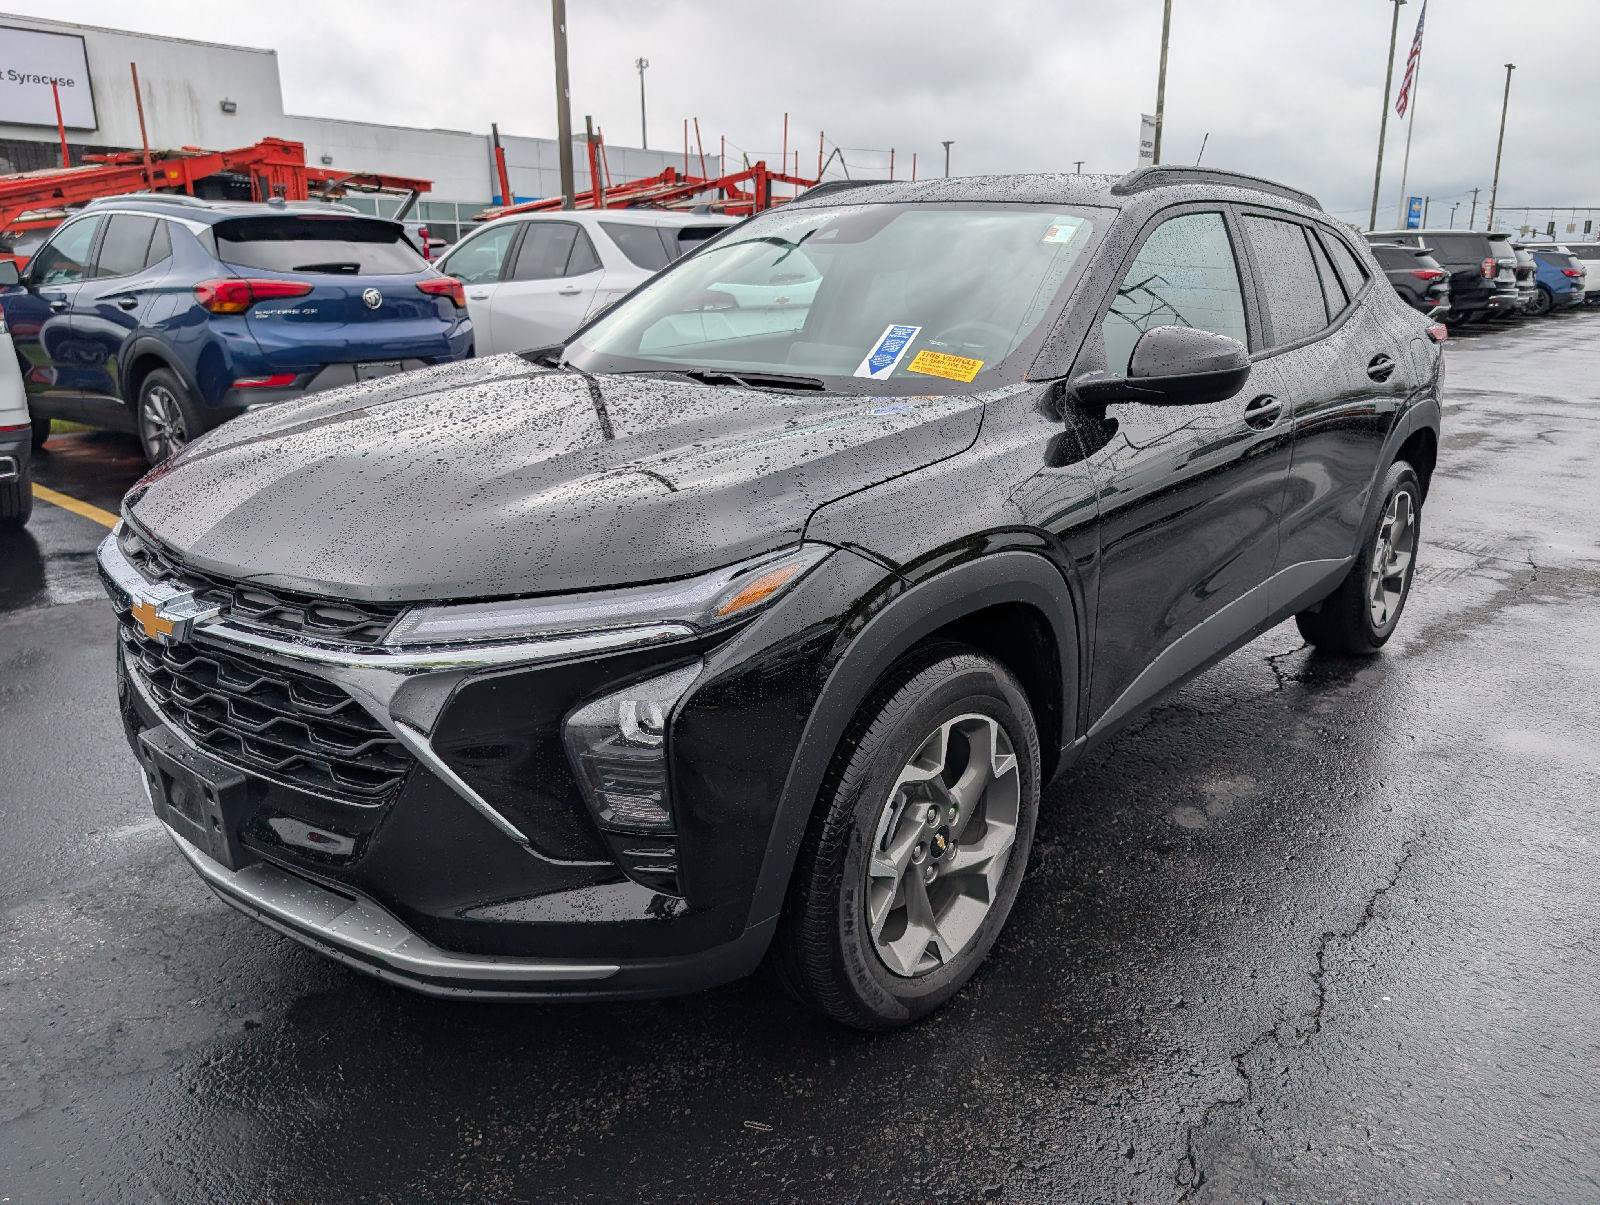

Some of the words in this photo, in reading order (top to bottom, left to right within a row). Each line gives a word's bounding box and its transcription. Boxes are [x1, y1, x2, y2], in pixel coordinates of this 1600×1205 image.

[7, 69, 75, 88] Syracuse
[921, 351, 941, 360] THIS
[942, 354, 978, 367] VEHICLE
